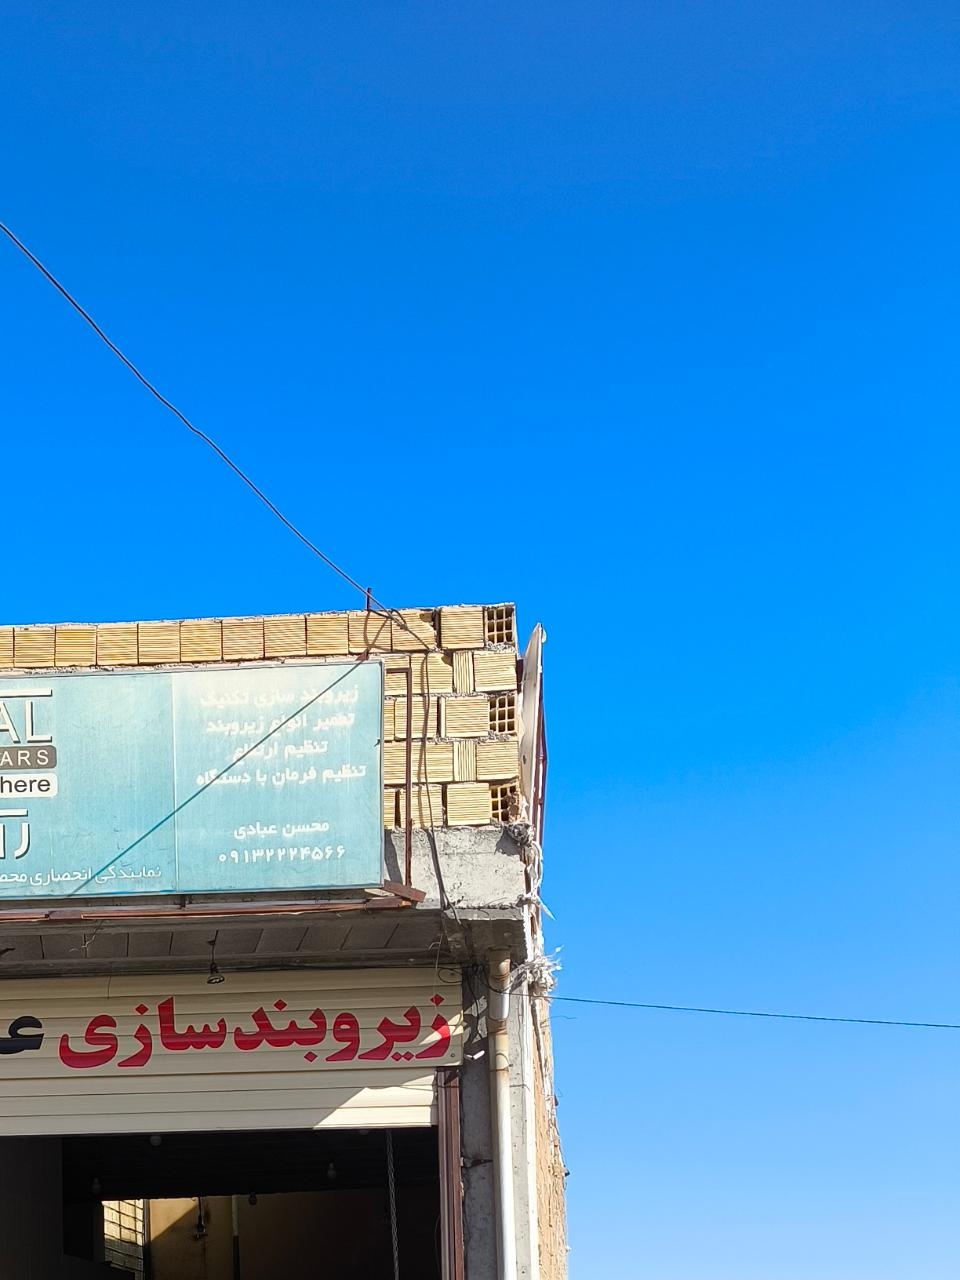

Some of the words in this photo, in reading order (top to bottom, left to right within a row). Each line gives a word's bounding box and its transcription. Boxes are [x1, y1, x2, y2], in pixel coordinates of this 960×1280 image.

[284, 739, 329, 759] تنظیم
[272, 766, 317, 785] فرمان
[322, 763, 368, 783] تنظیم
[233, 820, 278, 840] عبادی
[282, 821, 330, 839] محسن
[29, 866, 92, 886] انحصاری
[95, 865, 162, 885] نمایندگی
